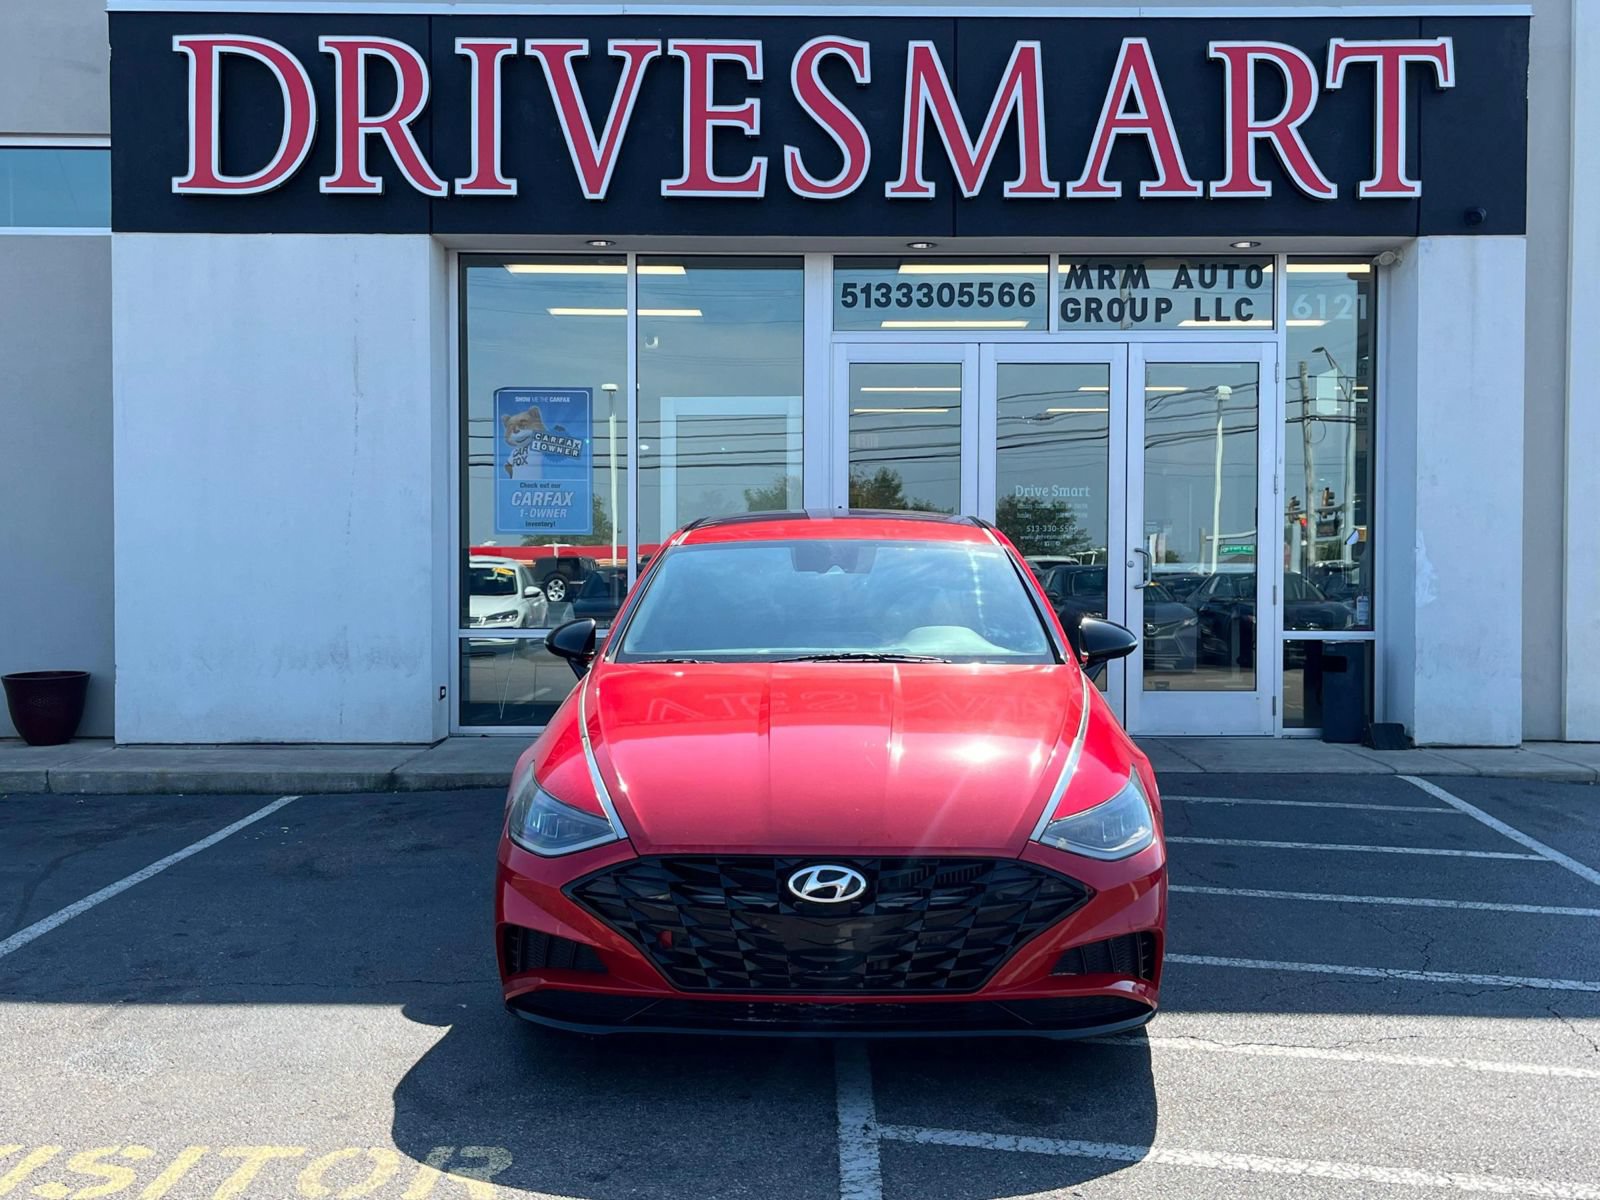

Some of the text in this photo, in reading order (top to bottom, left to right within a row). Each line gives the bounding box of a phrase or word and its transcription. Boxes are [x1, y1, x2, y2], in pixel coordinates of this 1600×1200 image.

[171, 34, 1456, 200] DRIVESMART
[1063, 263, 1264, 290] MRM AUTO
[841, 282, 1036, 309] 5133305566
[1292, 293, 1367, 320] 6121
[1060, 297, 1254, 323] GROUP LLC
[535, 433, 582, 449] CARFAX
[541, 444, 579, 457] OWNER
[512, 456, 529, 467] FOX
[511, 491, 574, 506] CARFAX
[1015, 484, 1090, 497] Drive Smart
[0, 1144, 514, 1200] ISITOR
